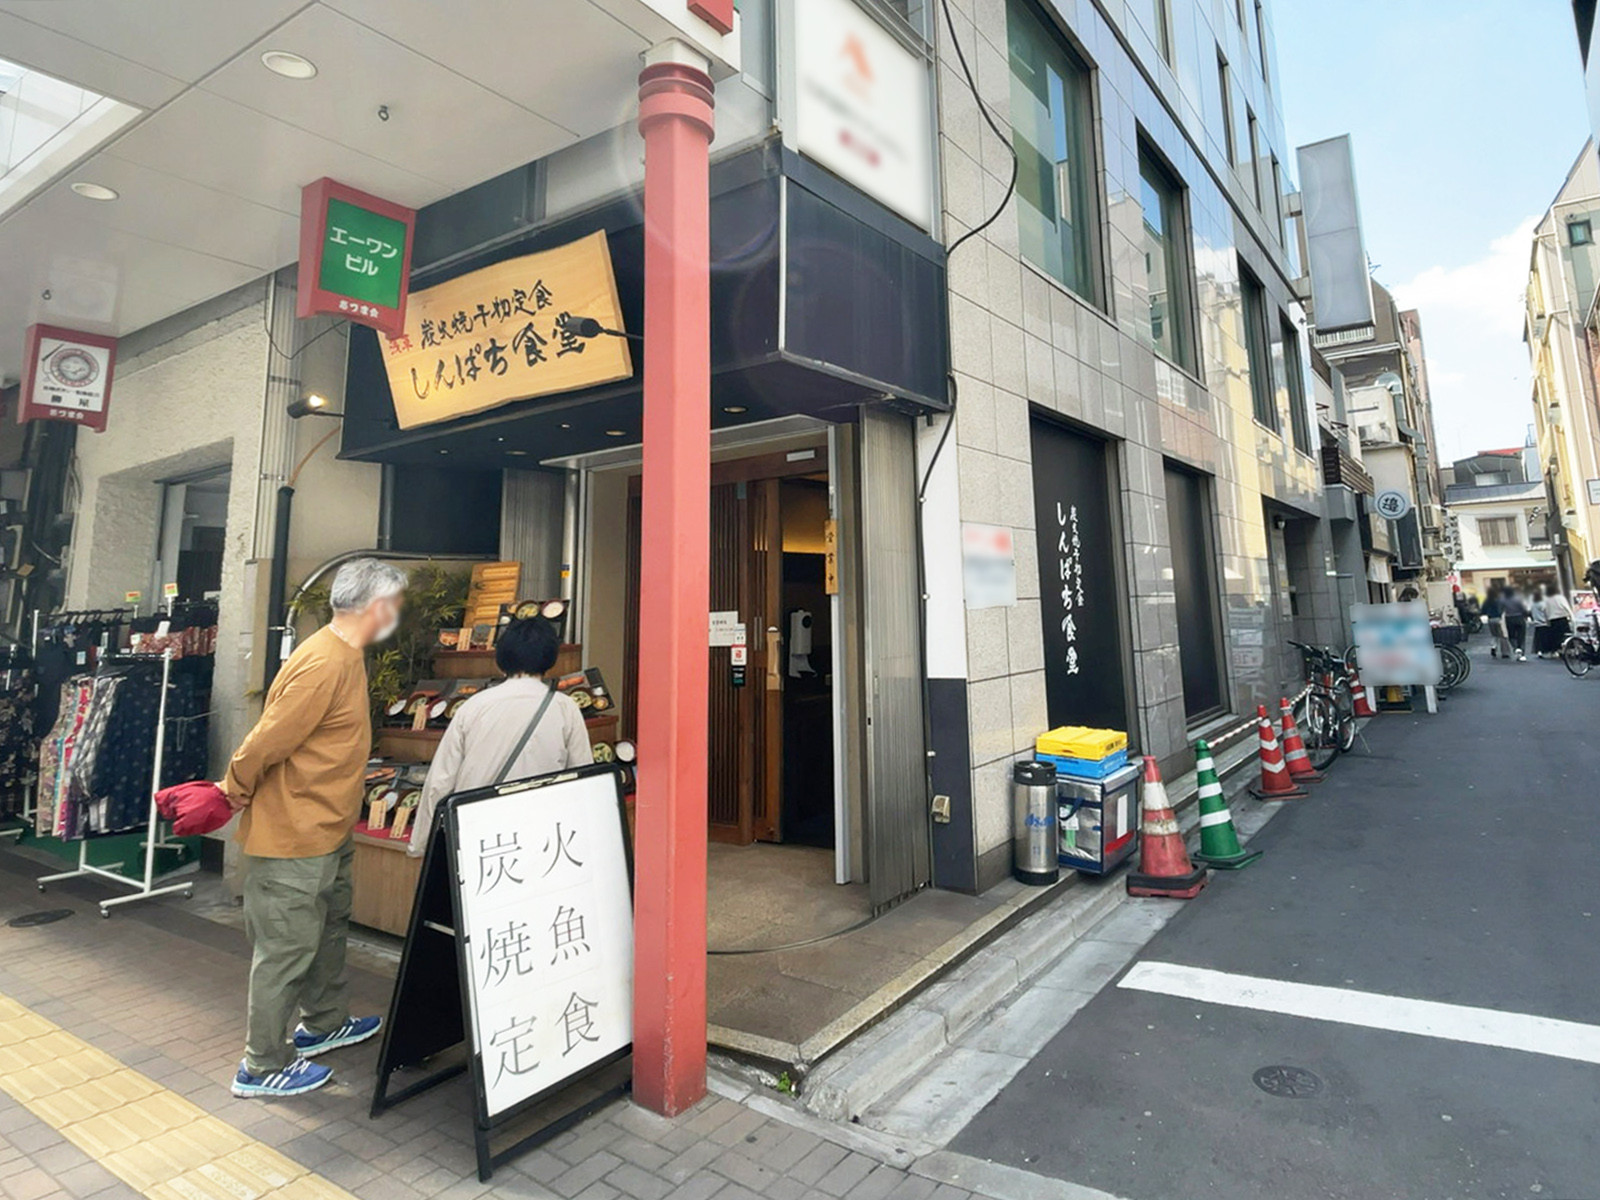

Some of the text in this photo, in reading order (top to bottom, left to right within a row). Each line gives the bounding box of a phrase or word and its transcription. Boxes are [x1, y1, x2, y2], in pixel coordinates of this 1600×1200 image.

[330, 226, 398, 258] エーワン
[345, 253, 379, 276] ビル
[420, 279, 553, 350] 炭火焼干物定食
[411, 311, 586, 400] しんぱち食堂
[1056, 502, 1079, 676] しんぱち食堂
[476, 822, 584, 897] 炭火
[479, 905, 591, 991] 焼魚
[489, 992, 600, 1090] 定食
